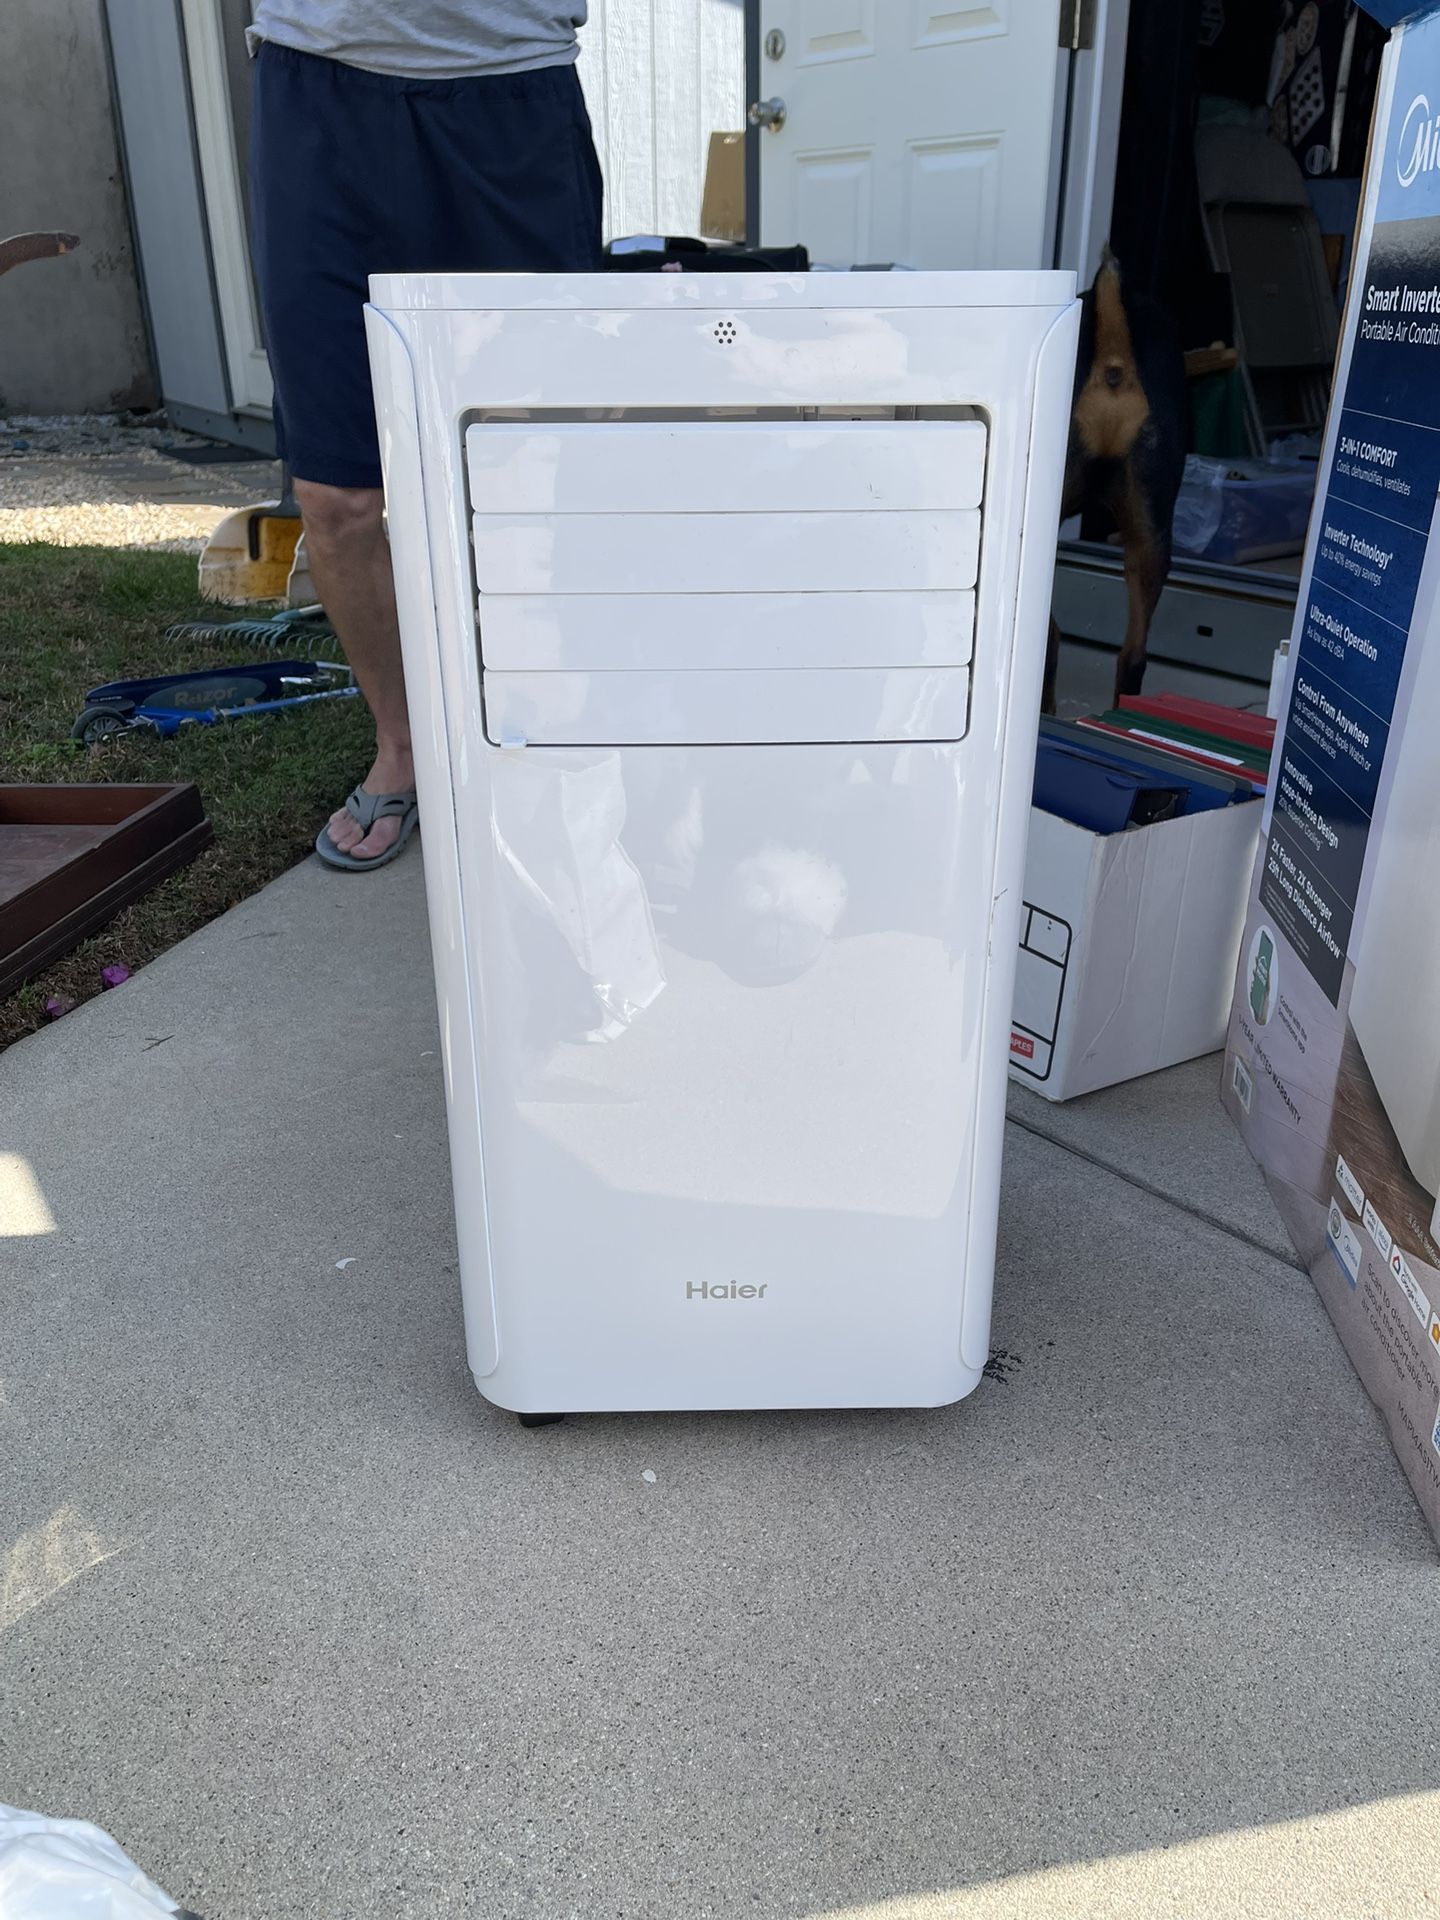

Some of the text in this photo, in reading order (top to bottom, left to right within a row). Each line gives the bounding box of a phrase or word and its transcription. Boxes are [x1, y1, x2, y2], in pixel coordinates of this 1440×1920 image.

[1397, 94, 1440, 187] Mi
[1366, 285, 1400, 311] Smart
[1360, 320, 1394, 341] Portable
[1393, 321, 1408, 342] Air
[1340, 436, 1398, 468] 3-IN-1 COMFORT
[1384, 477, 1411, 496] ventilates
[1324, 522, 1350, 547] Inverter
[1321, 544, 1329, 558] Up
[1328, 548, 1334, 560] to
[1344, 559, 1362, 577] energy
[1361, 568, 1382, 587] savings
[1310, 604, 1378, 662] Ultra-Quiet Operation
[1297, 677, 1369, 748] Control From Anywhere
[1320, 737, 1337, 760] devices
[1334, 732, 1349, 752] Apple
[1349, 744, 1365, 767] Watch
[1364, 761, 1372, 772] or
[1284, 756, 1313, 796] Innovative
[1281, 776, 1339, 848] Hose-In-Hose Design
[1271, 838, 1333, 921] 2X Faster, 2X Stronger
[1268, 857, 1280, 879] 25ft
[1279, 870, 1294, 899] Long
[1293, 889, 1318, 928] Distance
[1316, 921, 1341, 959] Airflow
[1272, 1071, 1302, 1125] WARRANTY
[686, 1280, 767, 1299] Haier
[1361, 1300, 1405, 1381] air conditioner
[1363, 1282, 1423, 1391] about the portable
[1367, 1263, 1383, 1295] Scan
[1383, 1290, 1391, 1308] to
[1390, 1308, 1419, 1359] discover
[1419, 1360, 1440, 1397] more
